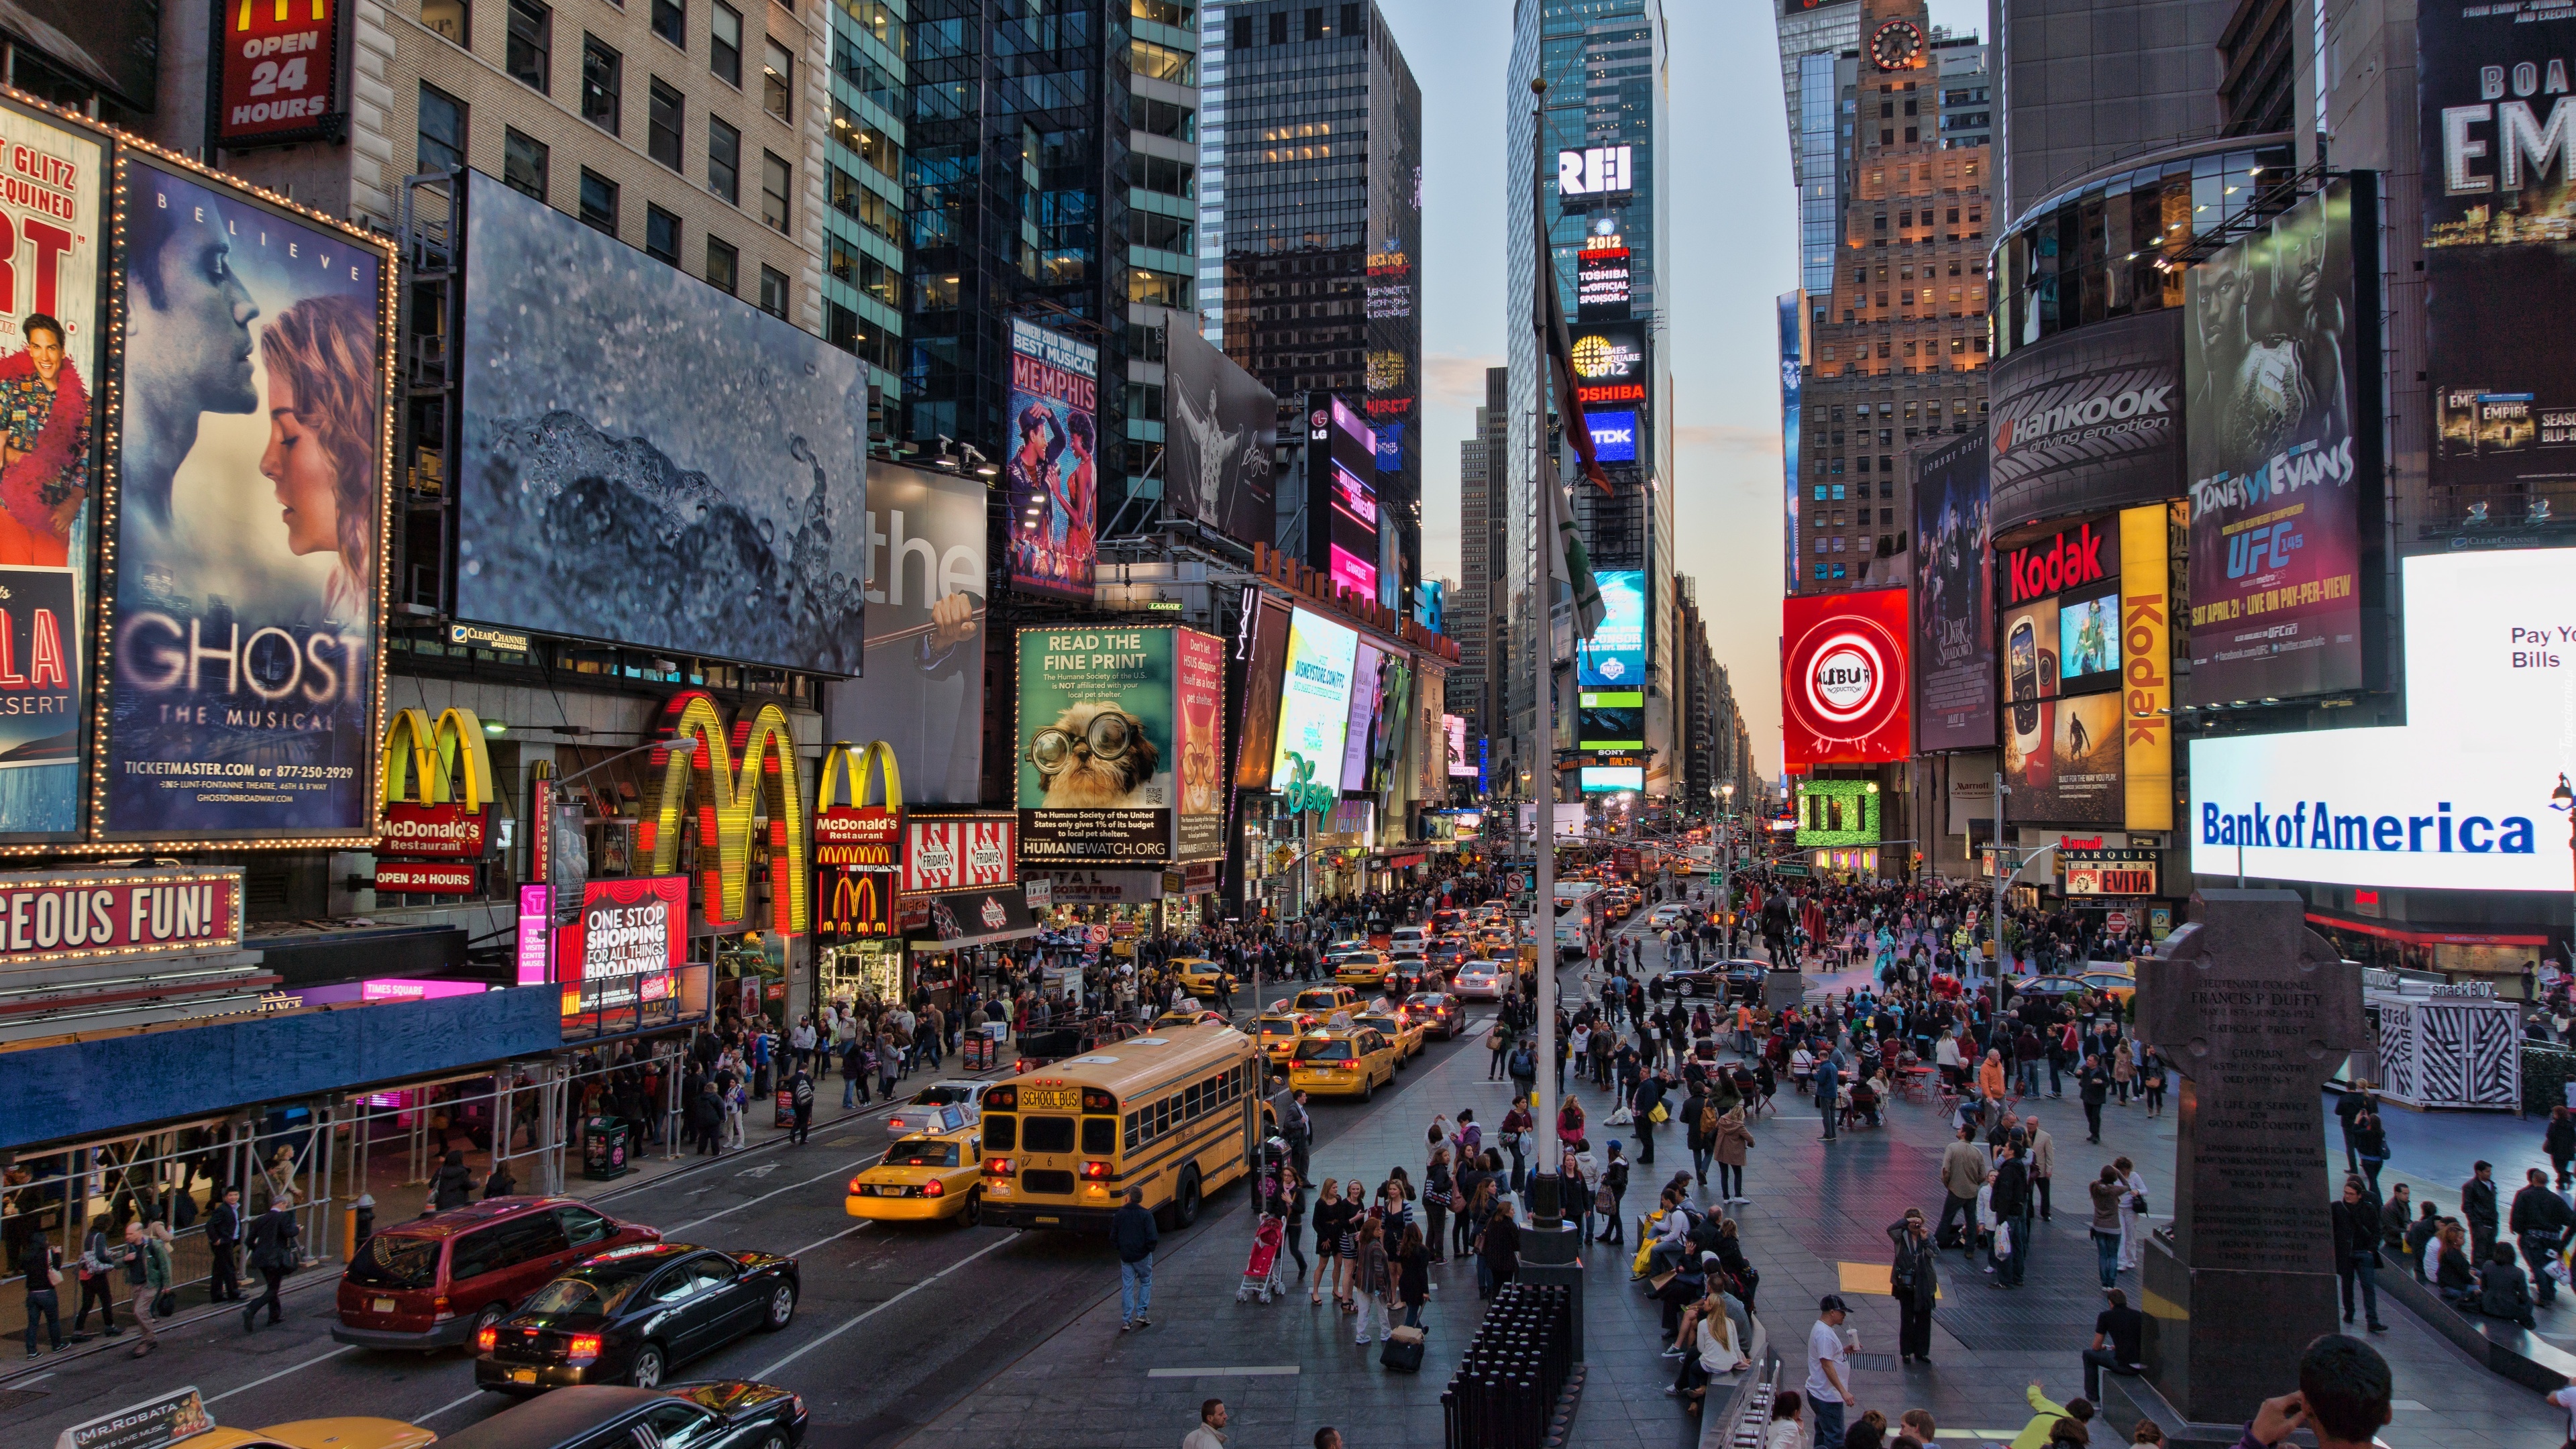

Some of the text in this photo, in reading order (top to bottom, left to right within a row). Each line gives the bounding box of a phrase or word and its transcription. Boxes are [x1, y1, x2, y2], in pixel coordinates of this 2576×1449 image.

[243, 31, 318, 59] OPEN
[250, 56, 308, 97] 24
[231, 95, 325, 125] HOURS
[14, 145, 74, 191] GLITZ
[1559, 146, 1631, 195] REI
[158, 194, 358, 280] BELIEVE
[1587, 235, 1621, 250] 2012
[1580, 248, 1630, 260] TOSHIBA
[1579, 270, 1629, 282] TOSHIBA
[1580, 294, 1620, 303] SPONSOR
[1014, 319, 1095, 361] WINNER! 2010 TONY AWARD
[1014, 333, 1095, 376] BEST MUSICAL
[1599, 346, 1627, 356] TIMES
[1604, 354, 1642, 362] SQUARE
[1014, 356, 1095, 410] MEMPHIS
[1338, 410, 1345, 424] LG
[2483, 406, 2529, 420] EMPIRE
[1312, 431, 1327, 439] LG
[1591, 429, 1631, 443] TDK
[2029, 416, 2169, 453] driving emotion
[1923, 436, 1984, 476] JOHNNY DEPP
[1340, 470, 1362, 498] BRILLIANCE
[2189, 436, 2354, 522] JONES VS EVANS
[2227, 521, 2303, 579] UFC 145
[865, 509, 985, 610] the
[2010, 523, 2104, 603] Kodak
[2192, 574, 2351, 627] SAT APRIL 21 LIVE ON PAY-PER-VIEW
[1943, 616, 1968, 644] DARK
[491, 641, 527, 651] SPECTACOLOR
[1049, 634, 1140, 651] READ THE
[1190, 638, 1203, 653] Don't
[1939, 635, 1972, 665] SHADOWS
[117, 612, 364, 704] GHOST
[1044, 653, 1146, 670] FINE PRINT
[1183, 654, 1216, 673] HSUS disguise
[2512, 651, 2560, 668] Bills
[1086, 673, 1111, 682] Society
[2126, 593, 2165, 747] Kodak
[1123, 683, 1138, 691] your
[1183, 672, 1216, 690] itself as a local
[1187, 692, 1213, 706] pet shelter.
[160, 704, 333, 731] THE MUSICAL
[1947, 713, 1958, 724] MAY
[1609, 757, 1633, 766] ITALY'S
[125, 761, 354, 779] TICKETMASTER.COM or 877-250-2929
[2106, 773, 2116, 782] PLAY.
[180, 780, 244, 789] LUNT-FONTANNE
[246, 781, 277, 790] THEATRE,
[279, 782, 297, 790] 46TH
[1955, 782, 1988, 790] Marriott
[197, 794, 293, 803] GHOSTONBROADWAY.COM
[1079, 812, 1106, 820] Society
[380, 820, 480, 839] McDonald's
[540, 824, 549, 833] 24
[817, 818, 897, 830] McDonald's
[1058, 821, 1073, 829] only
[1075, 821, 1093, 829] gives
[1128, 821, 1154, 829] budget
[2202, 801, 2535, 853] Bank of America
[1085, 830, 1097, 839] pet
[2060, 835, 2102, 849] Marriott
[390, 841, 461, 851] Restaurant
[1024, 843, 1165, 855] HUMANEWATCH.ORG
[1179, 841, 1218, 853] HUMANEWATCH.ORG
[2065, 851, 2156, 859] MARQUIS
[1778, 866, 1803, 874] Broadway
[376, 873, 470, 885] OPEN 24 HOURS
[2103, 871, 2150, 892] EVITA
[1053, 885, 1122, 894] COMPUTERS
[0, 885, 213, 951] EOUS FUN!
[588, 906, 665, 930] ONE STOP
[586, 924, 665, 950] SHOPPING
[588, 942, 665, 963] FOR ALL THINGS
[585, 955, 666, 982] BROADWAY
[367, 984, 423, 995] TIMES SQUARE
[2199, 979, 2312, 990] LIEUTENANT COLONEL
[2432, 981, 2496, 998] snackBOX
[2192, 991, 2251, 1005] FRANCIS
[2271, 994, 2322, 1006] DUFFY
[2382, 1006, 2412, 1027] snack
[2209, 1024, 2306, 1034] CATHOLIC PRIEST
[1023, 1091, 1077, 1106] SCHOOL BUS
[1047, 1156, 1052, 1167] 6
[82, 1403, 178, 1440] MR.ROBATA
